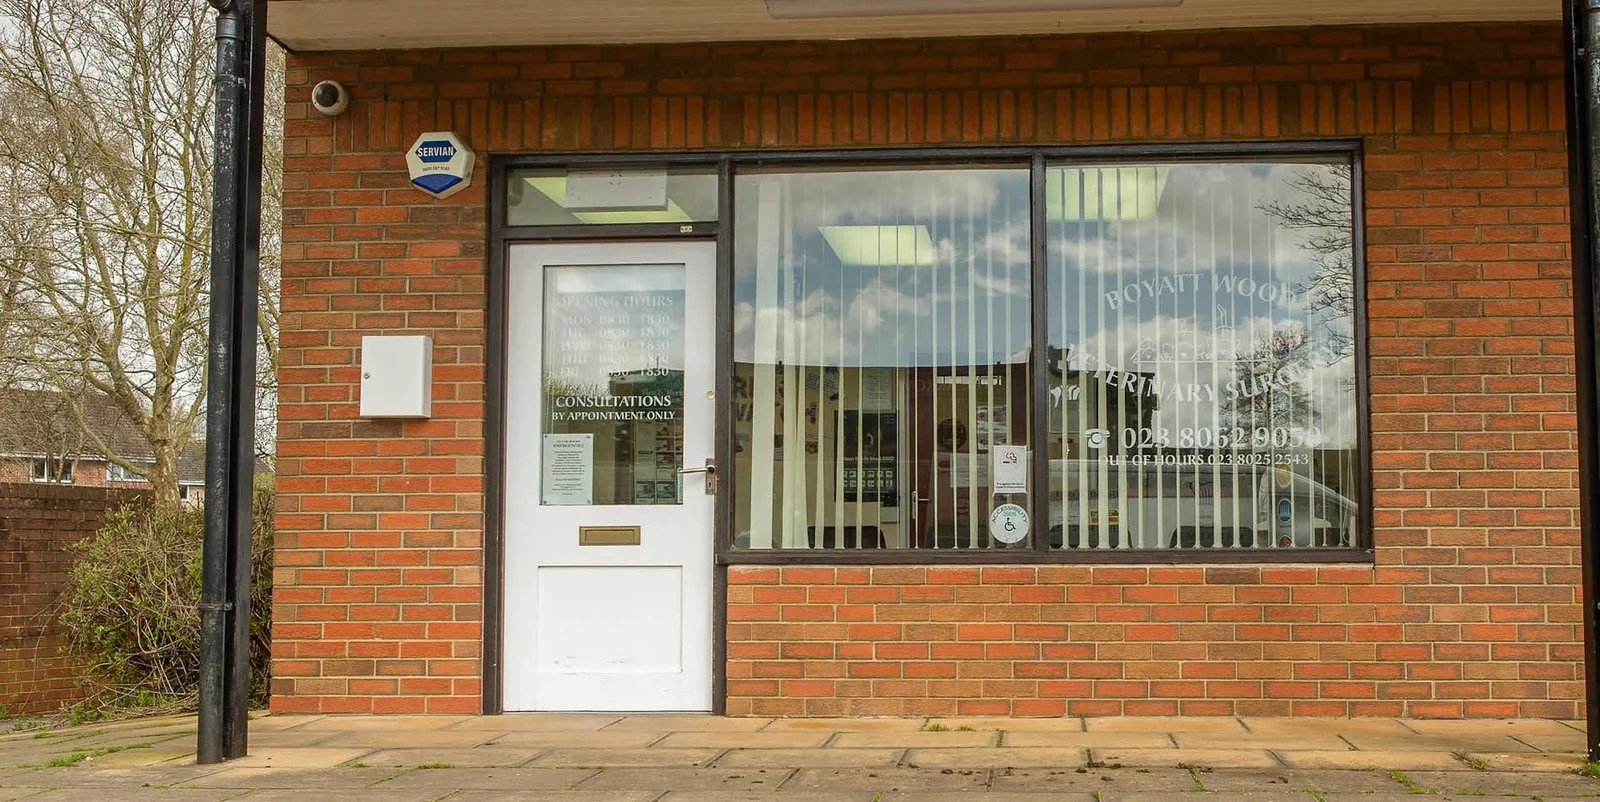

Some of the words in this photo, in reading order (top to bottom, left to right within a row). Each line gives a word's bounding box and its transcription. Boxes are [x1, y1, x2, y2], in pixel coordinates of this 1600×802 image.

[417, 146, 454, 157] SERVIAN
[1105, 273, 1204, 310] BOYATT
[1213, 273, 1297, 305] WOOD
[624, 295, 673, 308] HOURS
[561, 315, 592, 325] MON
[599, 314, 630, 325] 0830
[640, 314, 670, 325] 1830
[640, 365, 669, 377] 1830
[556, 395, 671, 408] CONSULTATIONS
[552, 411, 565, 420] BY
[567, 411, 646, 421] APPOINTMENT
[647, 410, 676, 420] ONLY
[1123, 427, 1170, 449] 023
[1179, 427, 1246, 449] 8062
[1099, 454, 1129, 466] OUT
[1132, 454, 1151, 466] OF
[1154, 454, 1204, 466] HOURS
[1208, 453, 1232, 466] 023
[1238, 453, 1271, 466] 8025
[1275, 453, 1309, 465] 2543
[991, 505, 1028, 524] ACCESSIBILITY
